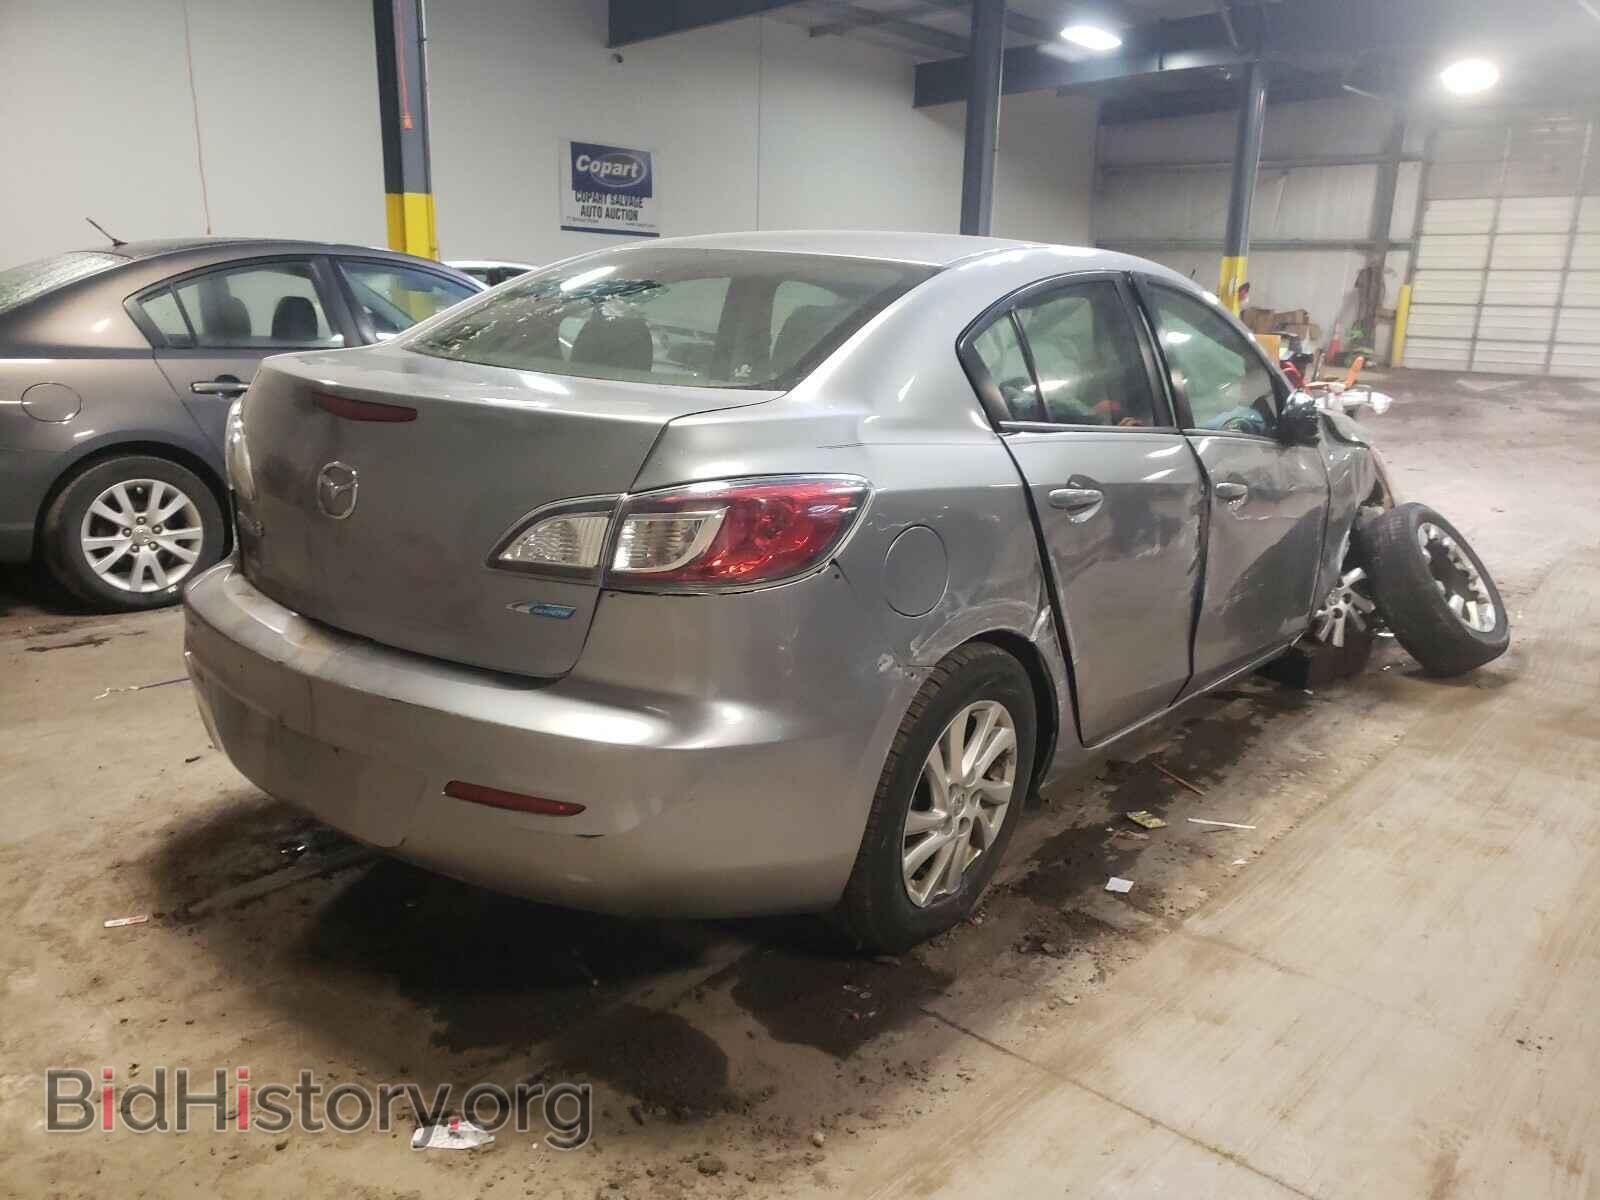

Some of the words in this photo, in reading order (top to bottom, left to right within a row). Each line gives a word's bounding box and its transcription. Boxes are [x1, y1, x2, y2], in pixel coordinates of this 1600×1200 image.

[576, 155, 638, 178] Copart
[576, 191, 608, 204] COPART
[580, 205, 602, 218] AUTO
[605, 207, 639, 221] AUCTION
